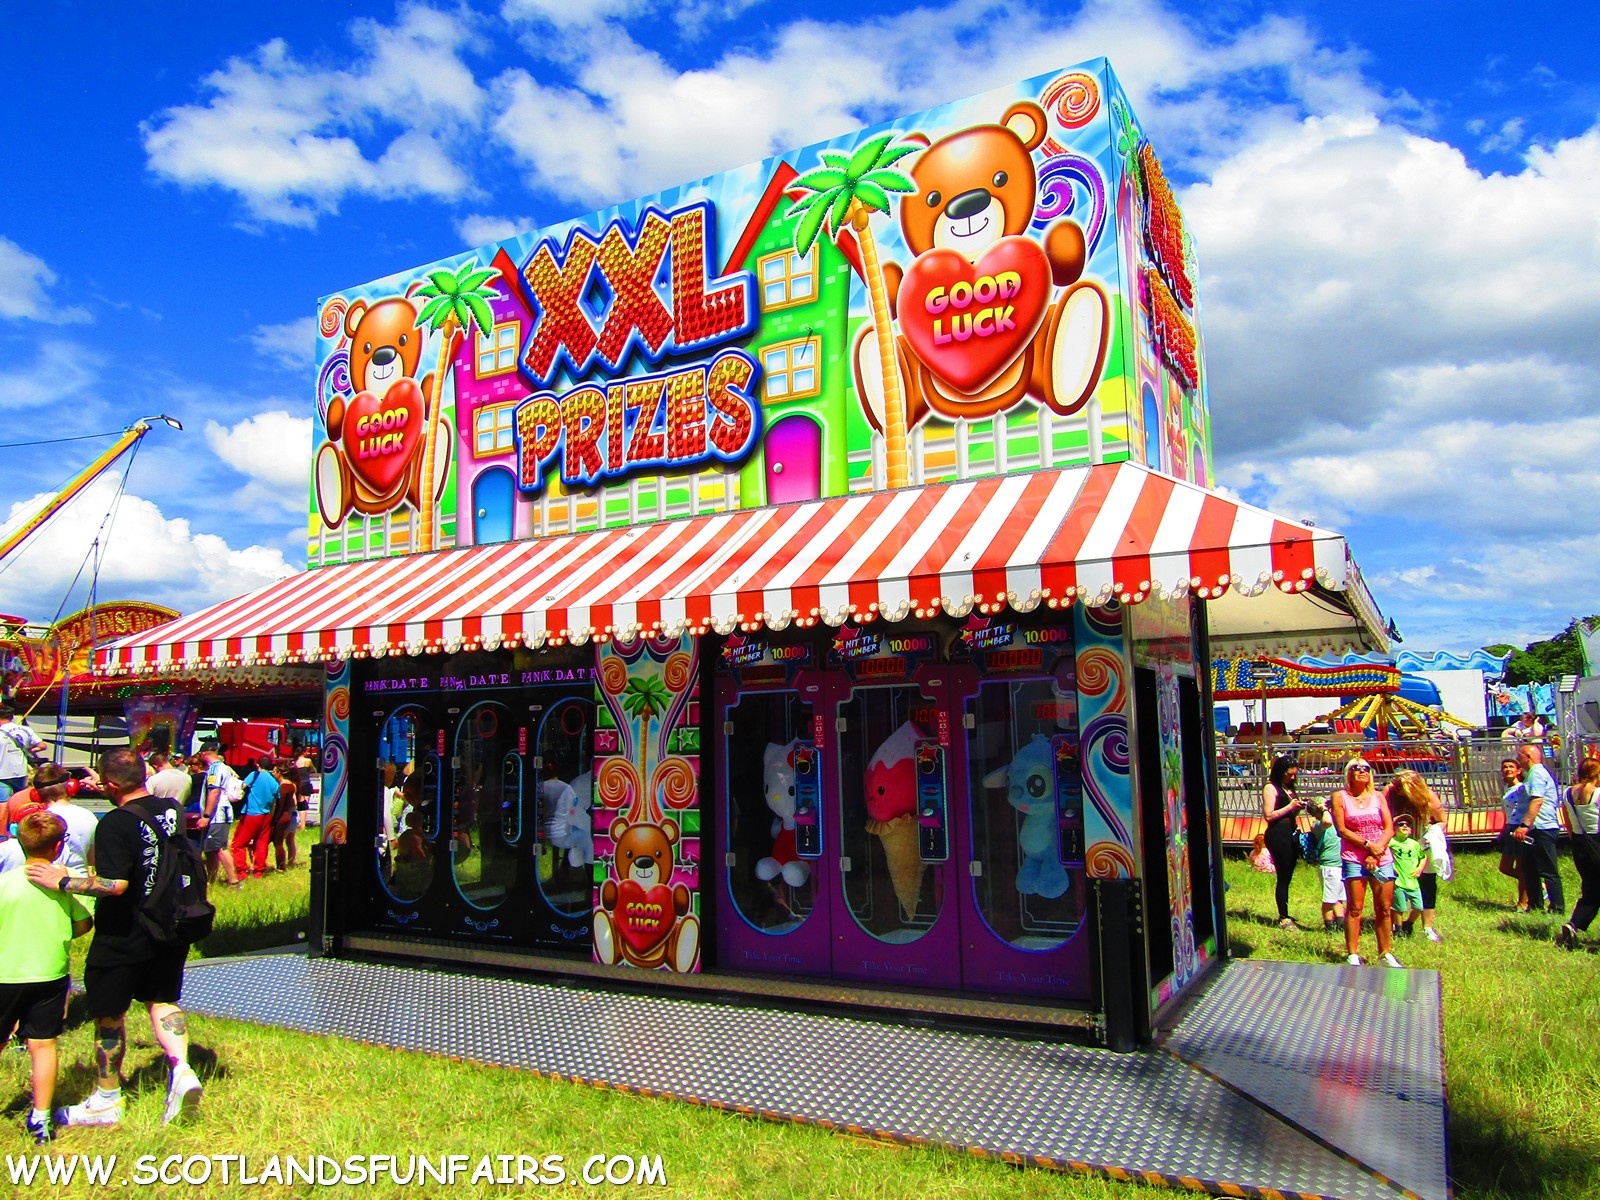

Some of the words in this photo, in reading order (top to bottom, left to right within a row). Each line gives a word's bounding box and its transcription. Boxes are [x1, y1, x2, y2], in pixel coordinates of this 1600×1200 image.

[521, 208, 749, 381] XXL
[925, 271, 1022, 315] GOOD
[932, 305, 1016, 346] LUCK
[356, 407, 409, 437] GOOD
[515, 355, 755, 488] PRIZES
[358, 432, 404, 459] LUCK
[975, 629, 991, 640] HIT
[994, 624, 1013, 635] THE
[732, 647, 746, 656] HIT
[748, 642, 763, 652] THE
[845, 640, 860, 650] HIT
[862, 634, 879, 645] THE
[889, 638, 928, 652] 10.000
[391, 677, 428, 689] DATE
[470, 673, 509, 686] DATE
[626, 902, 662, 918] GOOD
[628, 917, 660, 932] LUCK
